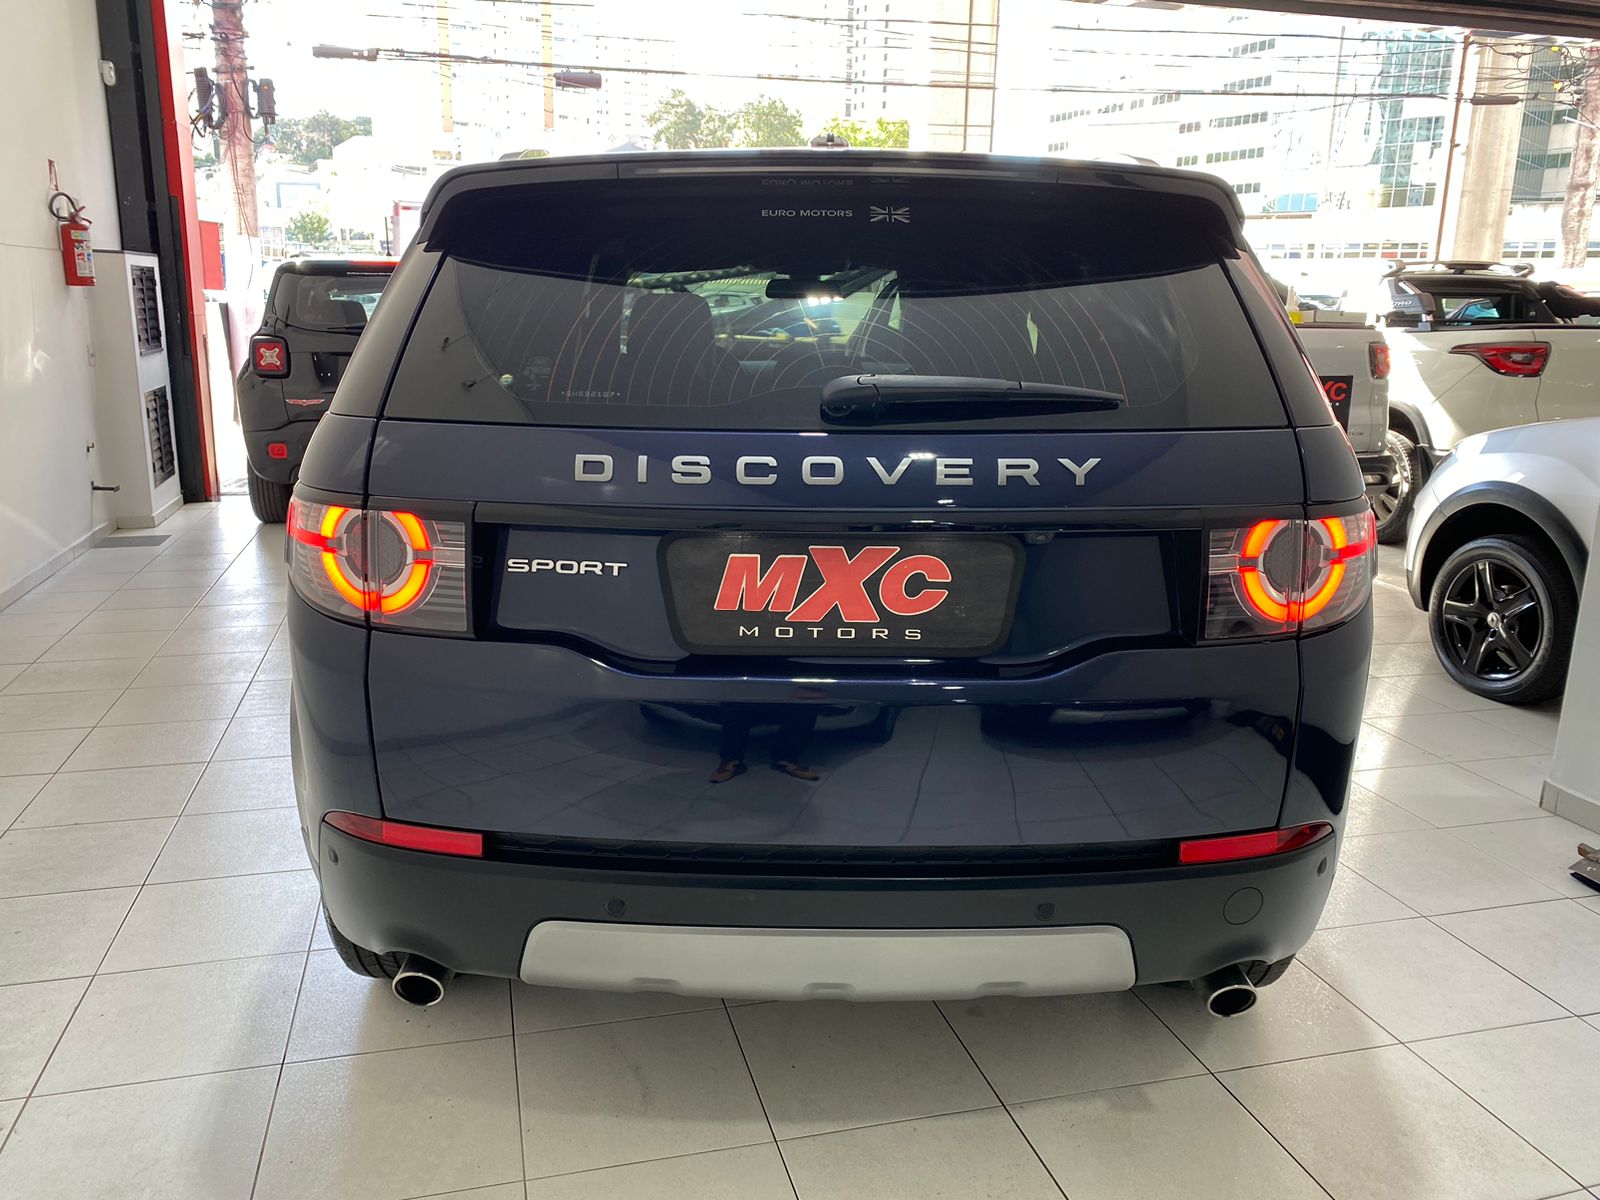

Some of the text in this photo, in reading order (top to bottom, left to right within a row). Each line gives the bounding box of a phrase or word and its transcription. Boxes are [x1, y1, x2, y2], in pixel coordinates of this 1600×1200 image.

[761, 209, 853, 217] EURO MOTORS
[574, 454, 1102, 486] DISCOVERY
[507, 558, 628, 576] SPORT
[713, 545, 952, 623] MXC
[739, 626, 922, 640] MOTORS
